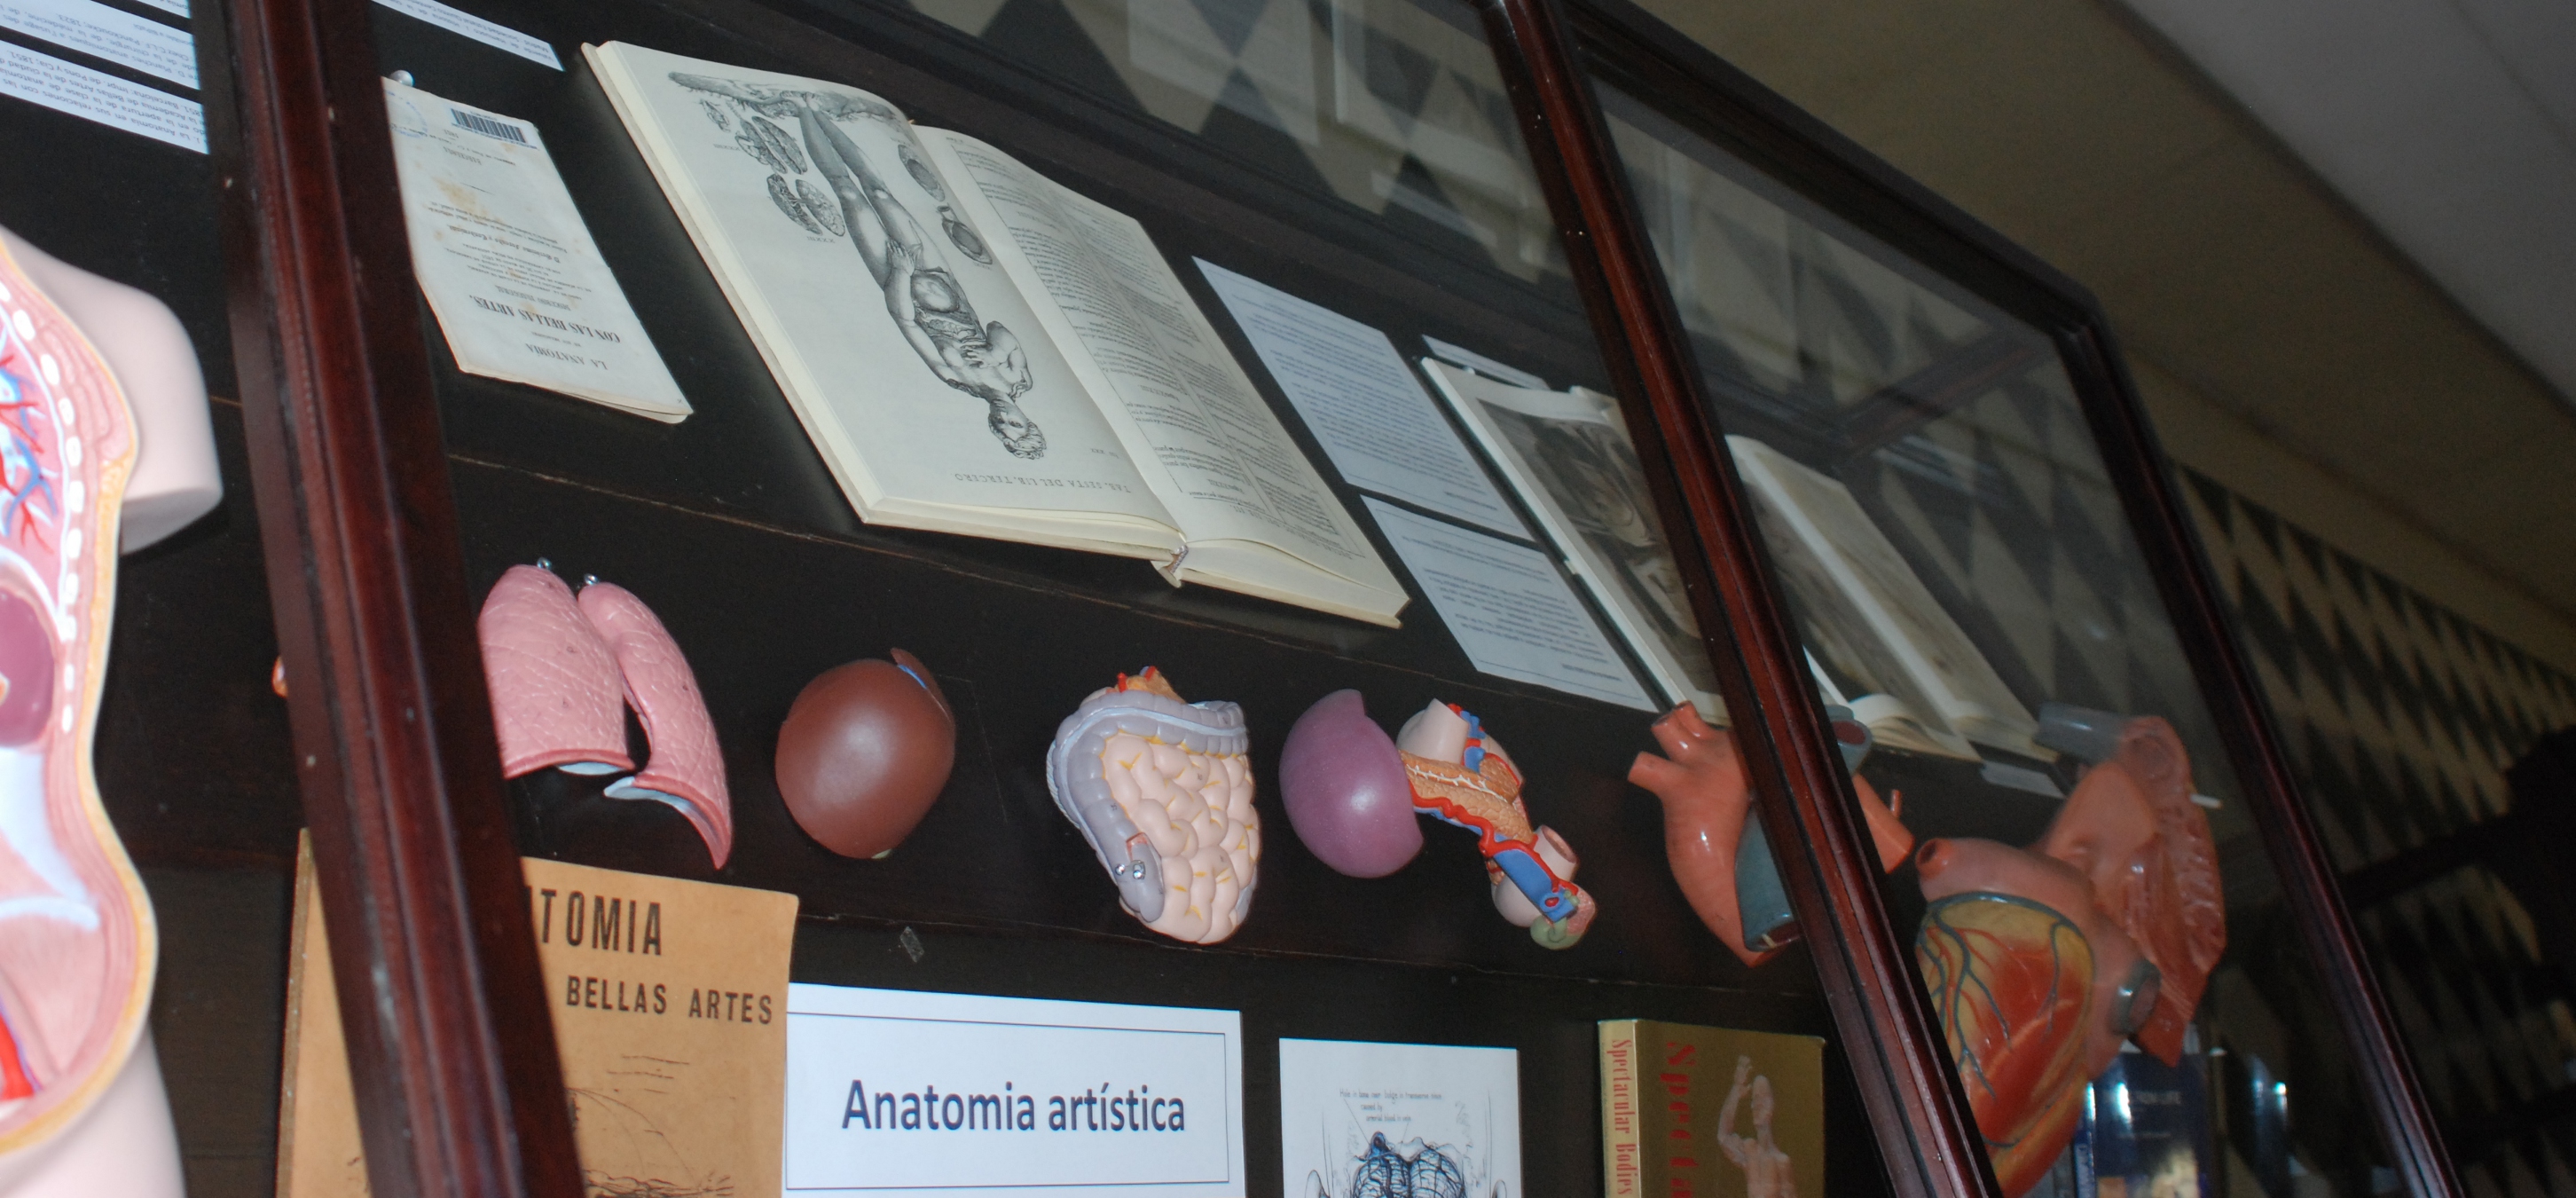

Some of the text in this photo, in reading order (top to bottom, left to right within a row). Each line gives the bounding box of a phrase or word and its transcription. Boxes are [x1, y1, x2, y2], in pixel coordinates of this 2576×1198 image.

[8, 60, 40, 75] ciudad
[64, 68, 87, 81] Pons
[3, 78, 17, 88] las
[20, 84, 38, 93] con
[69, 80, 93, 91] Artes
[43, 91, 90, 109] relaciones
[66, 88, 89, 99] clase
[97, 89, 124, 101] Bellas
[122, 106, 161, 121] apertura
[141, 102, 185, 120] Academia
[470, 296, 620, 343] CON LAS BELLAS ARTES.
[591, 359, 607, 369] LA
[1013, 477, 1037, 485] LIB.
[1067, 480, 1102, 489] SESTA
[1104, 483, 1131, 493] TAB.
[526, 886, 663, 956] TOMIA
[566, 975, 773, 1024] BELLAS ARTES
[842, 1078, 1186, 1131] Anatomia artística
[1606, 1039, 1639, 1196] Spectacular Bodies
